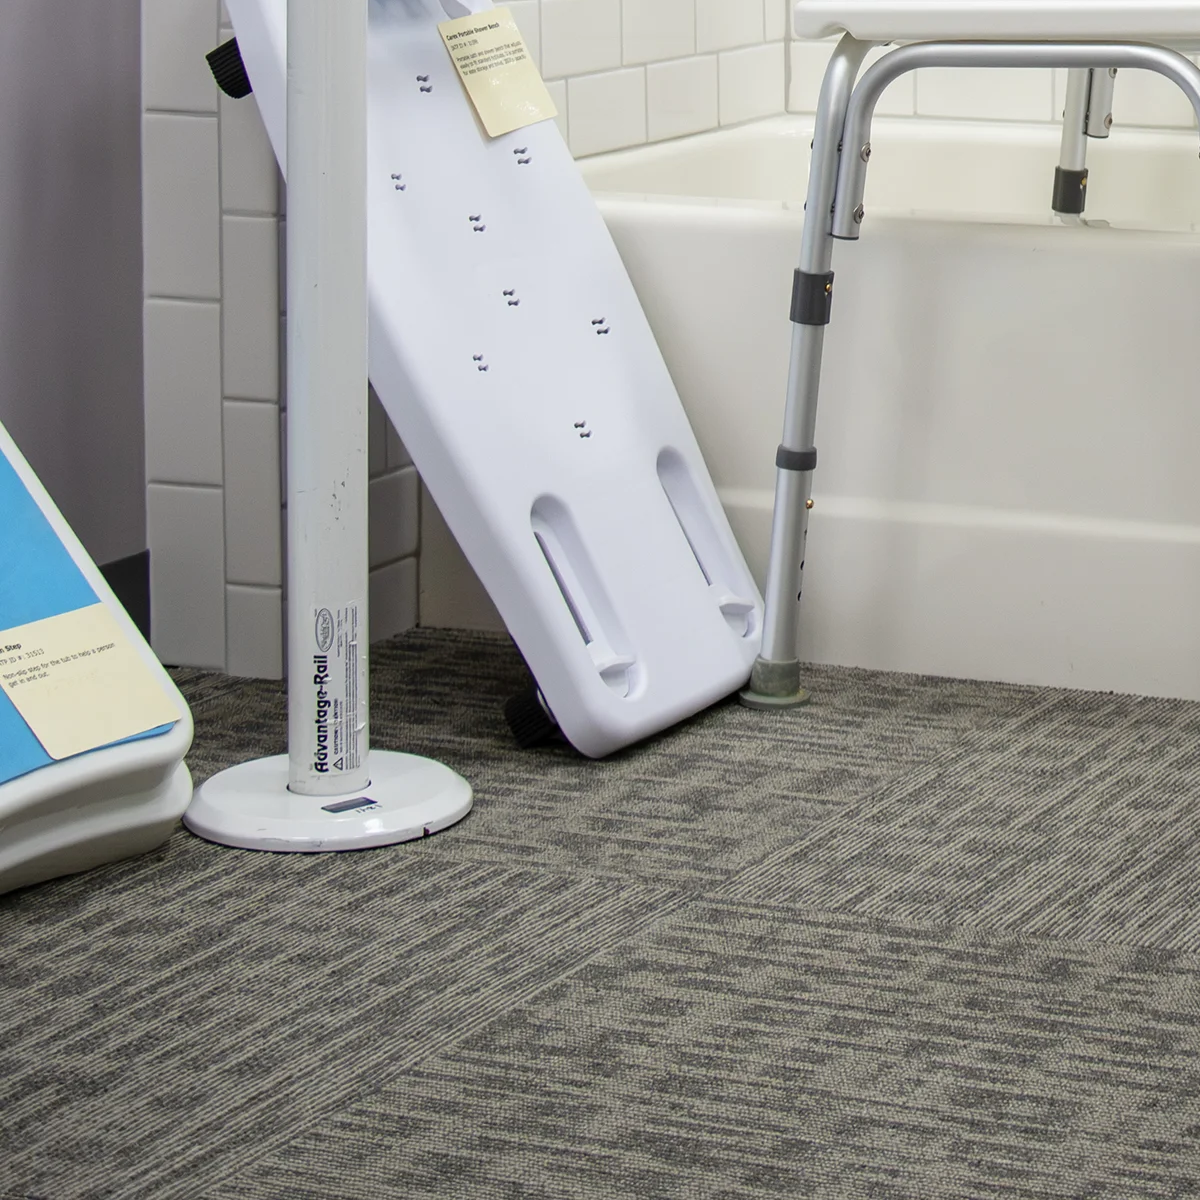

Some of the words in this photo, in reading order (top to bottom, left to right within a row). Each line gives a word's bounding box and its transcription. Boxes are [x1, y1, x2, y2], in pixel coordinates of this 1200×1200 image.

[3, 668, 27, 679] Non-slip
[97, 642, 115, 652] person
[5, 643, 22, 652] Step
[314, 656, 331, 772] Advantage-Rail
